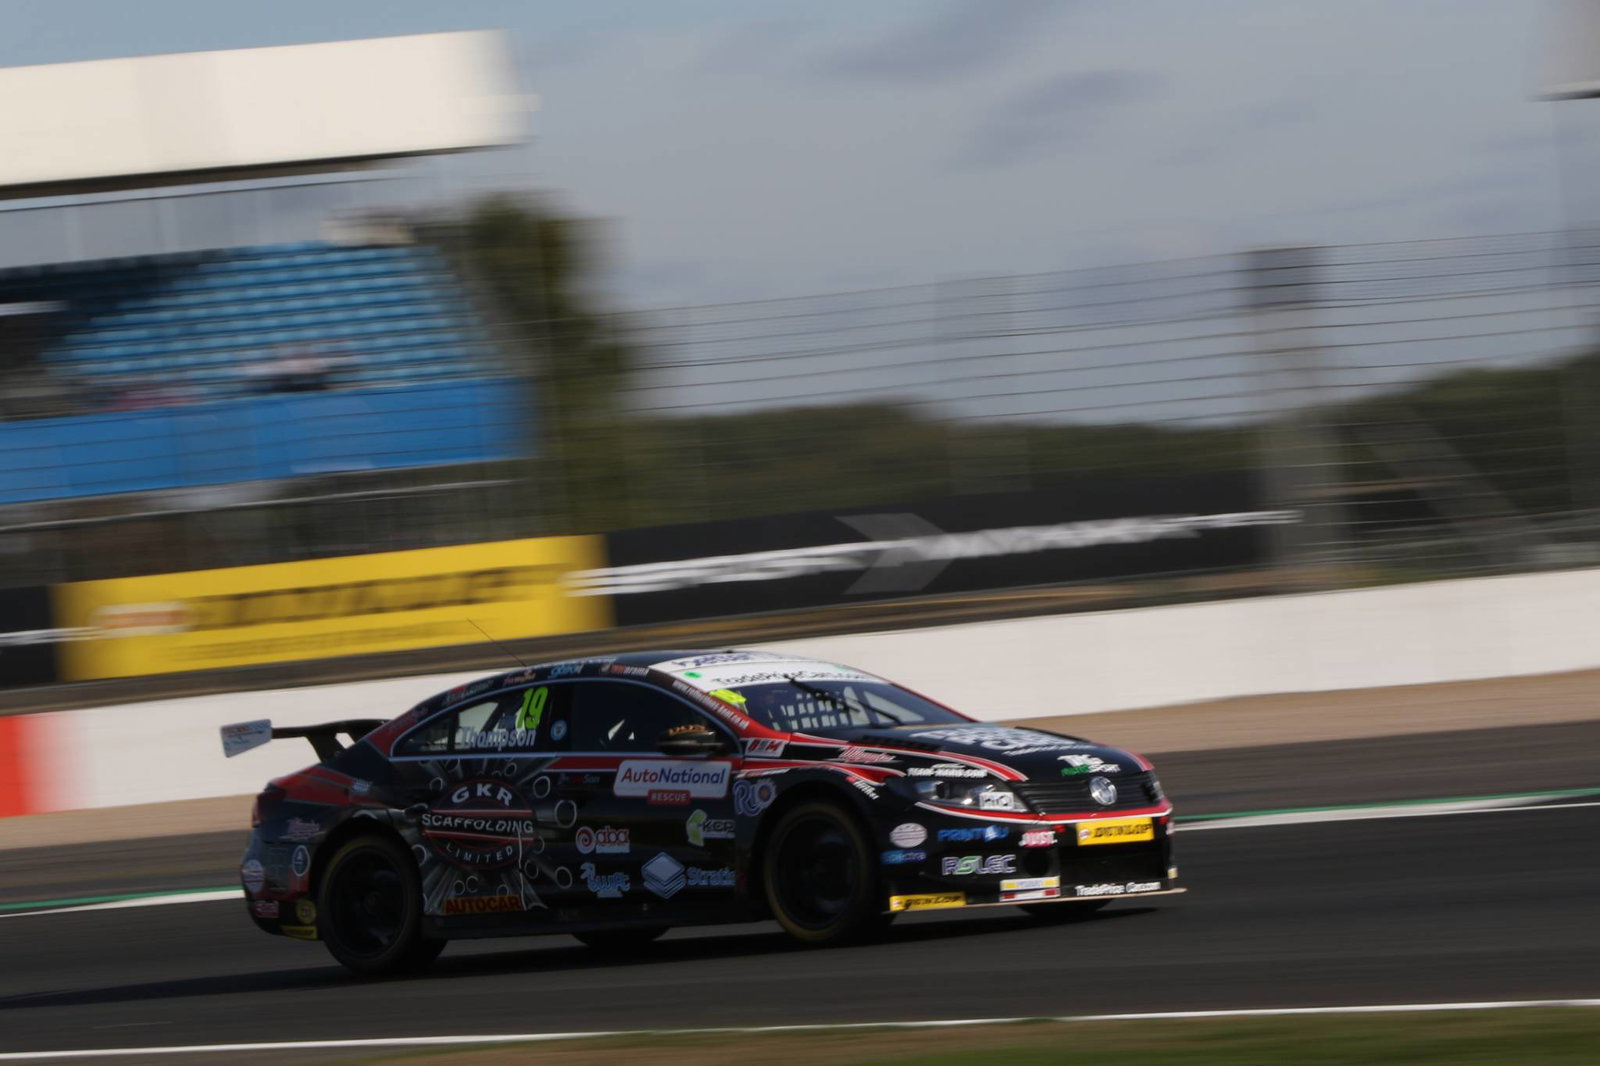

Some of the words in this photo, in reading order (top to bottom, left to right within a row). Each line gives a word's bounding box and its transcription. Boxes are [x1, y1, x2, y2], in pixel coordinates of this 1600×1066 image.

[517, 686, 549, 730] 19
[460, 726, 537, 751] Thompson
[621, 768, 726, 784] AutoNational
[451, 783, 513, 806] GKR
[651, 793, 687, 801] RESCUE
[421, 813, 534, 834] SCAFFOLDING
[1094, 823, 1152, 838] DUNLOP
[446, 843, 513, 863] LIMITED
[446, 896, 521, 915] AUTOCAR
[905, 896, 961, 909] DUNLOP
